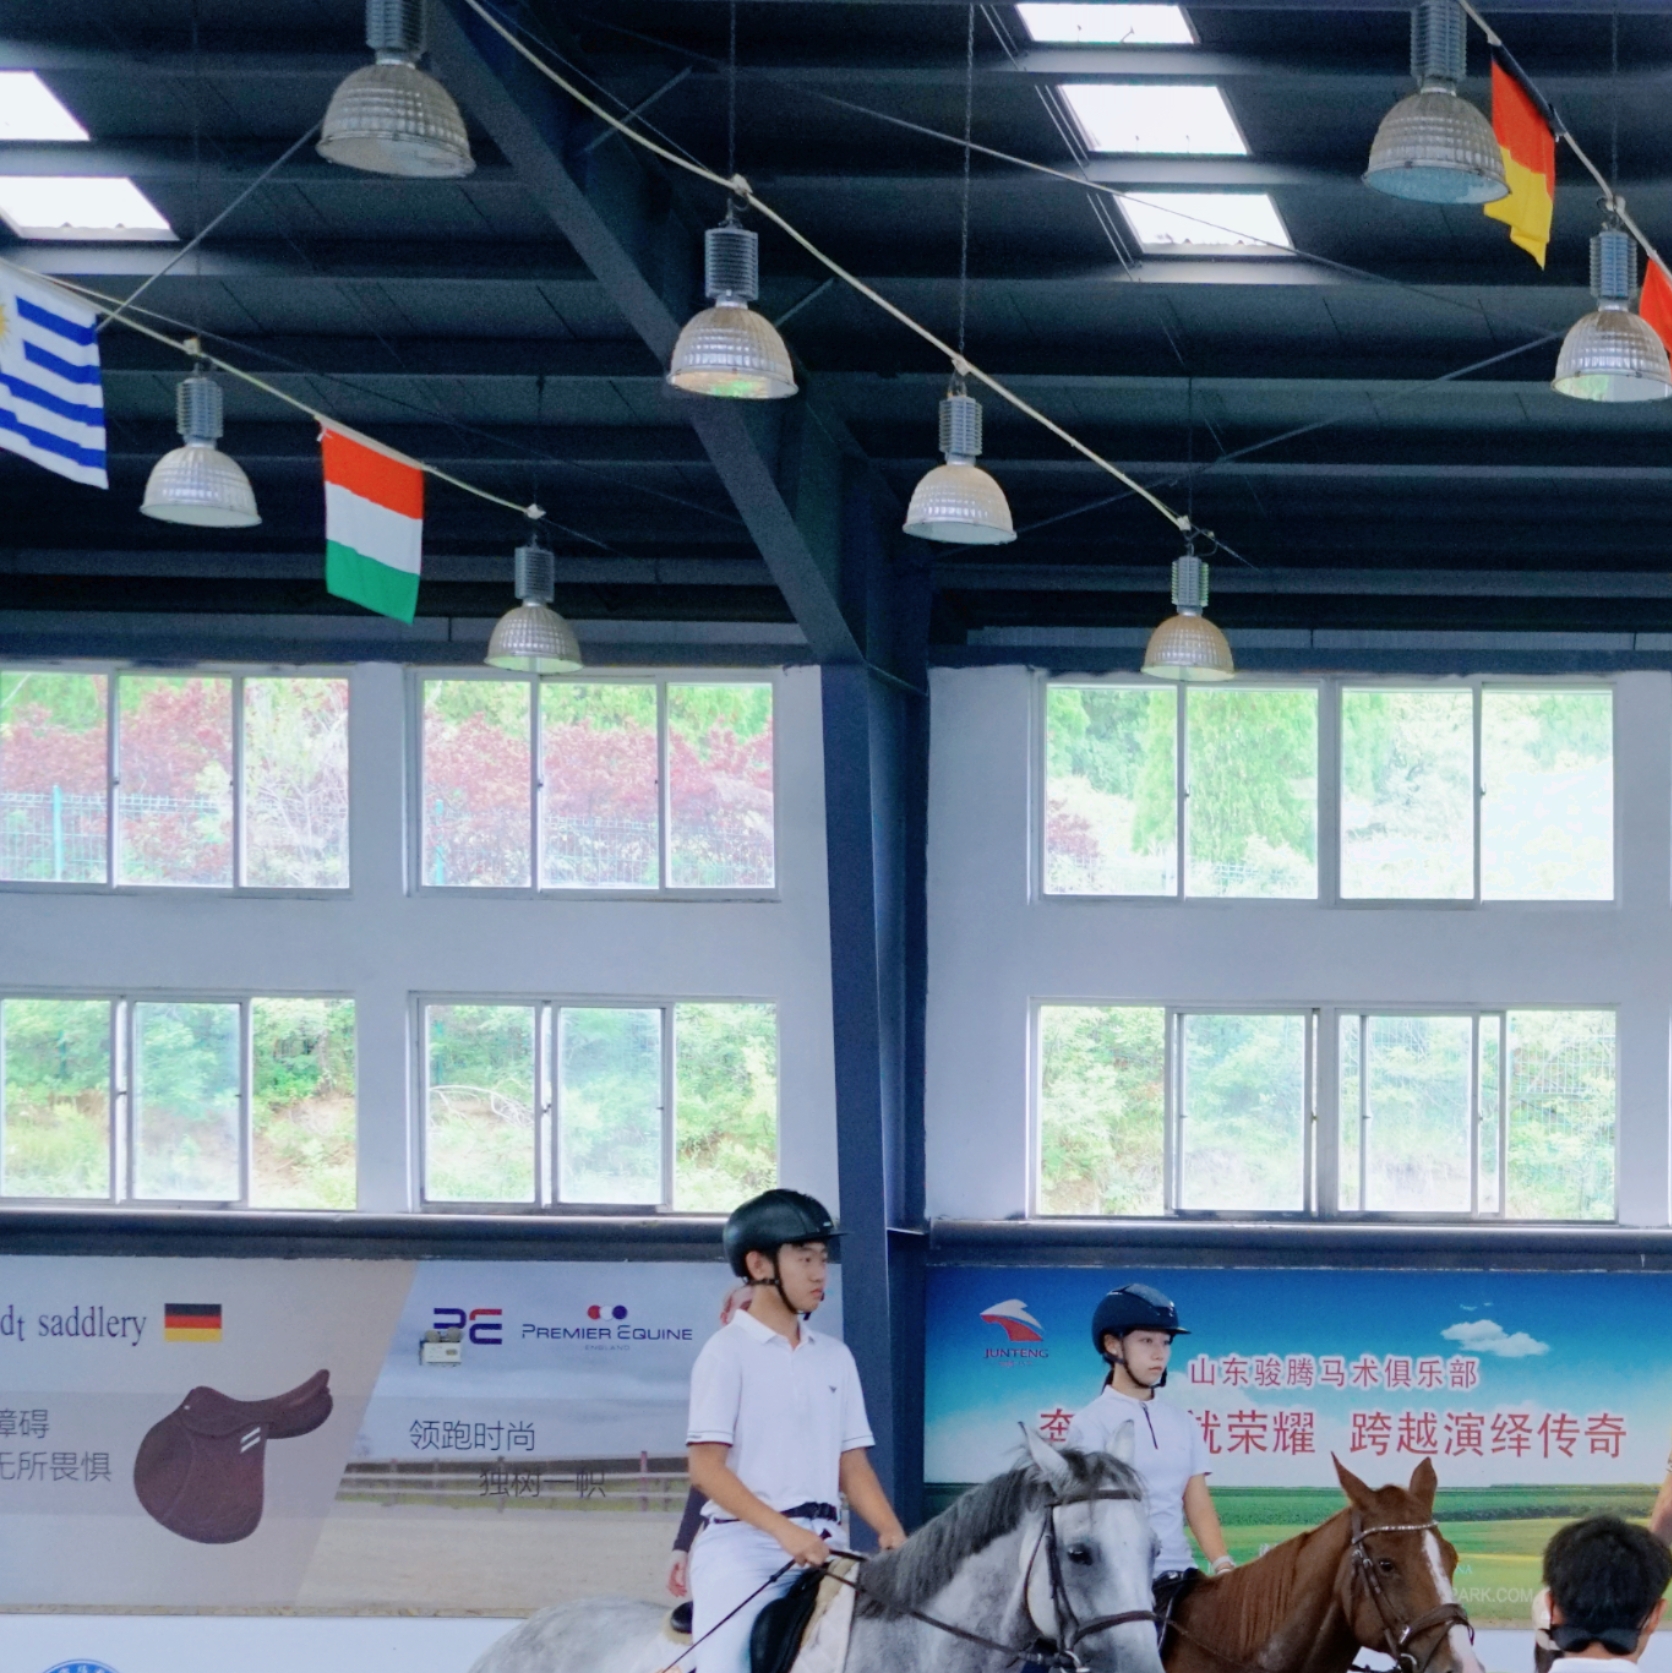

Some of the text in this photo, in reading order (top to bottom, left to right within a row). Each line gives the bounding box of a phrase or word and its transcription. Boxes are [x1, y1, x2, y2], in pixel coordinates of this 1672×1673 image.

[0, 1304, 147, 1347] dt saddlery
[521, 1324, 693, 1341] PREMIER EQUINE
[985, 1348, 1049, 1359] JUNTENG
[1190, 1356, 1478, 1389] 山东骏腾马术俱乐部
[409, 1420, 536, 1451] 领跑时尚
[1350, 1411, 1627, 1459] 跨越演绎传奇
[479, 1470, 606, 1498] 独树一帜
